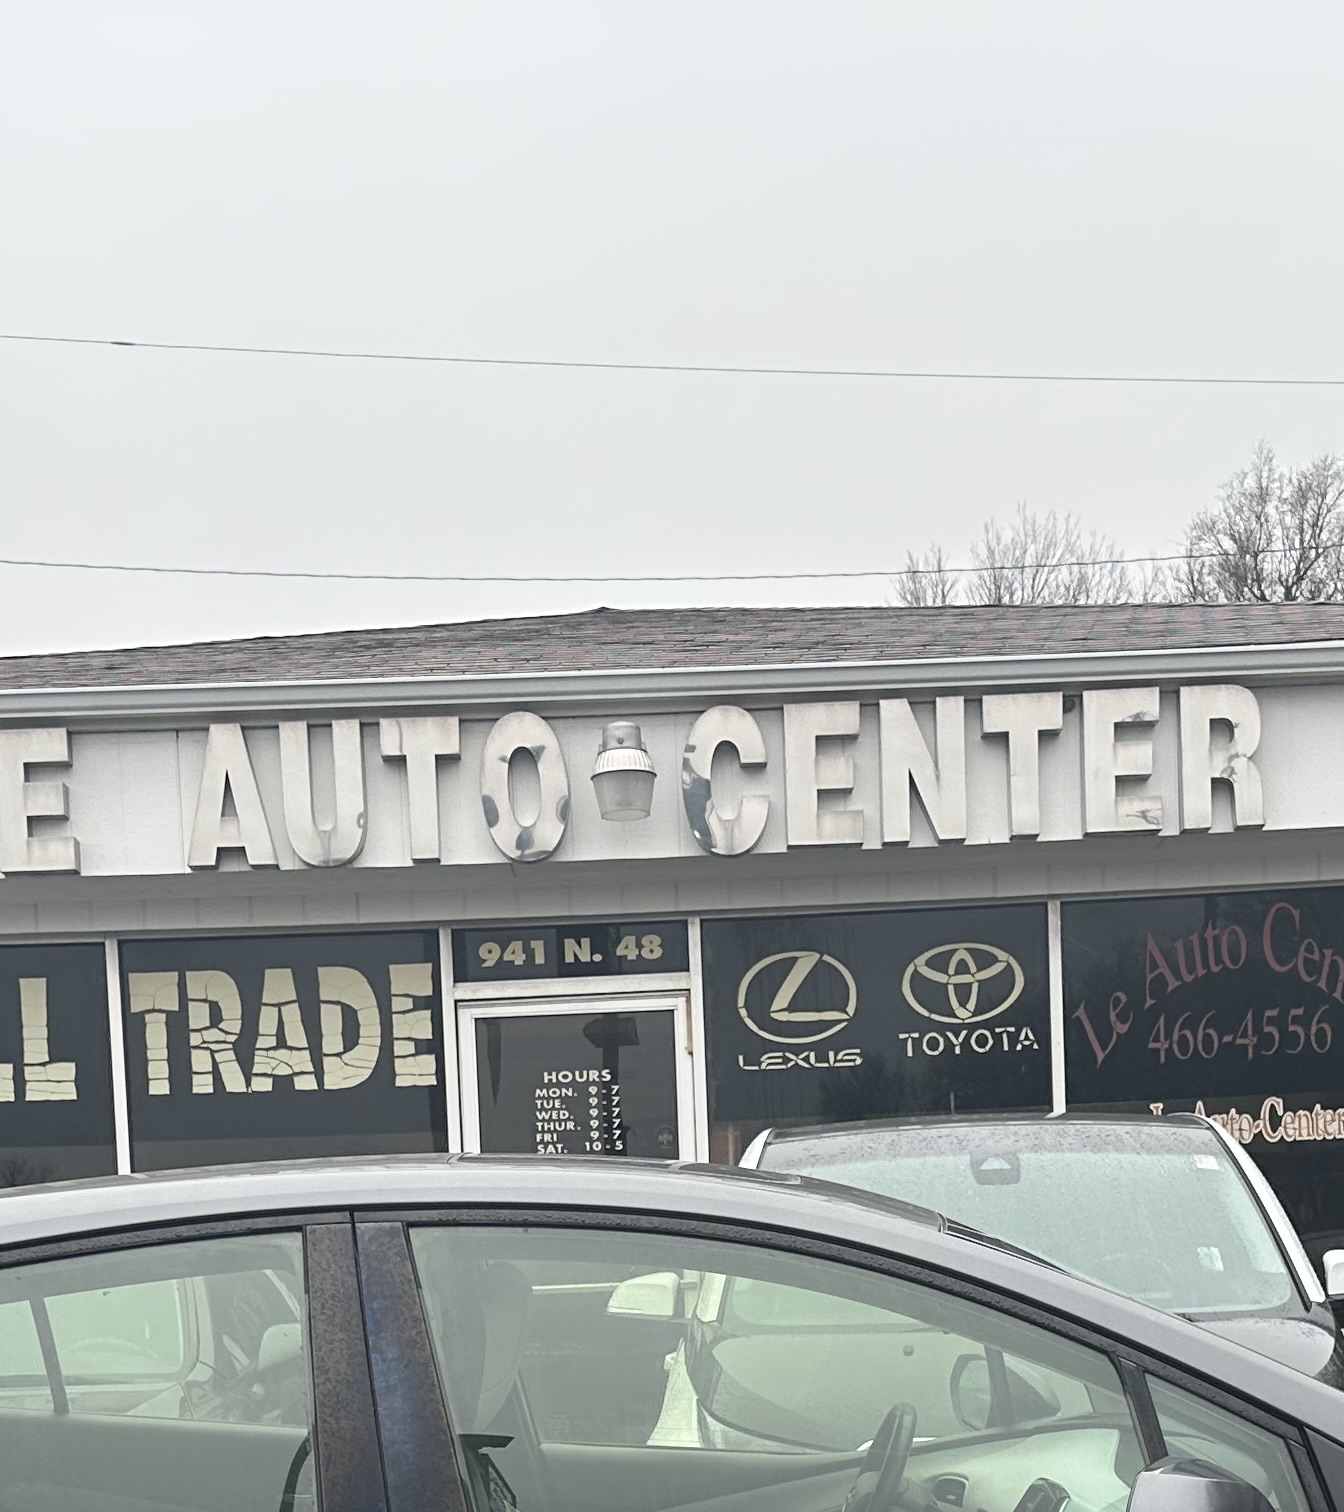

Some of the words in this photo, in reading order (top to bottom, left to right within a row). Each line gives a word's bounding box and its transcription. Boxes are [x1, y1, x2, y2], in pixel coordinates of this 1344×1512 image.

[187, 711, 568, 869] AUTO
[681, 684, 1264, 856] CENTER
[479, 940, 546, 967] 941
[564, 937, 602, 963] N.
[616, 934, 663, 960] 48
[1072, 991, 1134, 1069] Le
[1144, 920, 1247, 1010] Auto
[128, 963, 437, 1095] TRADE
[1147, 1004, 1332, 1064] 466-4556
[898, 1027, 1039, 1058] TOYOTA
[738, 1049, 863, 1070] LEXUS
[543, 1069, 612, 1083] HOURS
[535, 1088, 577, 1098] MON.
[535, 1099, 566, 1109] TUE.
[536, 1110, 574, 1120] WED.
[536, 1121, 581, 1131] THUR.
[536, 1132, 558, 1142] FRI
[537, 1143, 568, 1154] SAT.
